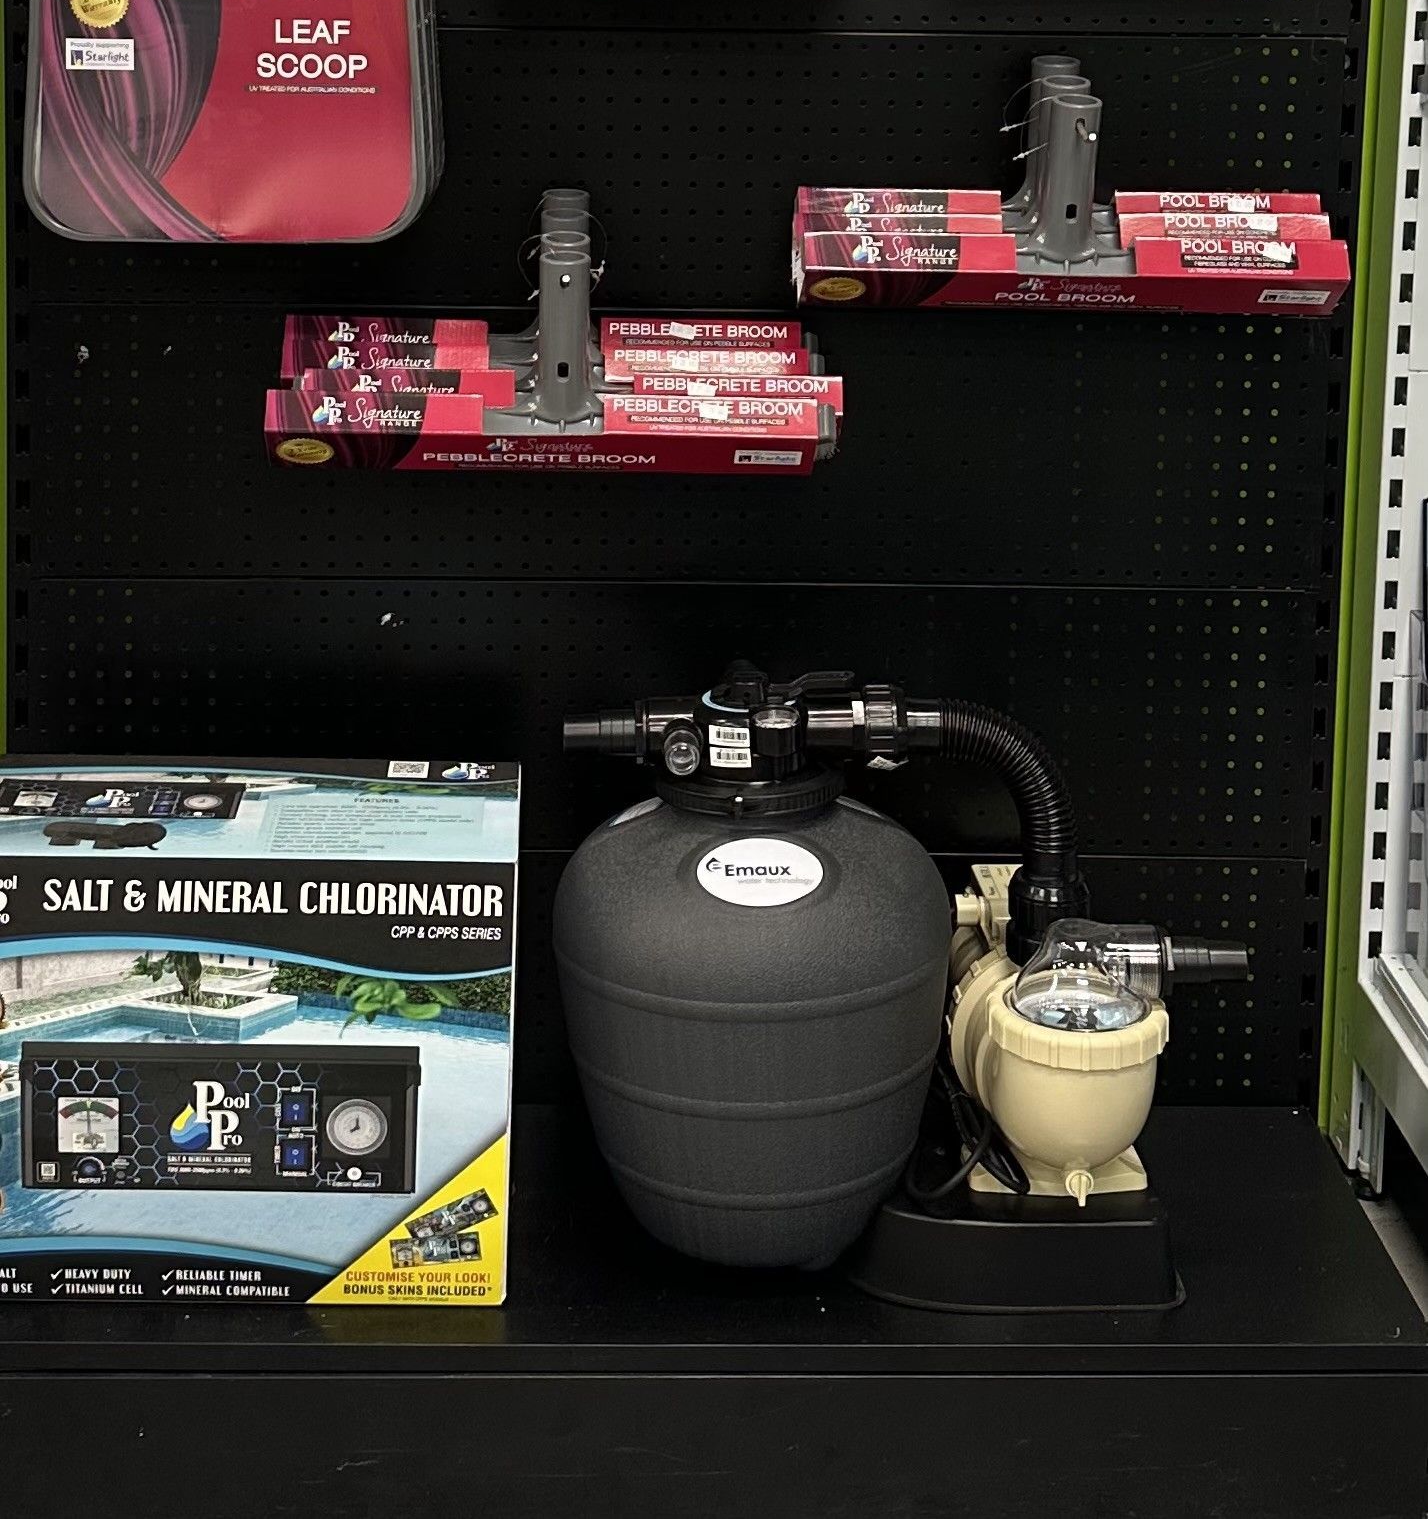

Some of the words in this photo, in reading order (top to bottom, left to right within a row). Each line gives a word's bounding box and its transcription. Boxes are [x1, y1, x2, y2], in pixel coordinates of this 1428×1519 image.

[275, 19, 350, 44] LEAF
[85, 50, 129, 62] Starlight
[257, 53, 367, 79] SCOOP
[1160, 195, 1205, 208] POOL
[1164, 215, 1211, 228] POOL
[886, 236, 958, 266] Signature
[1181, 240, 1228, 254] POOL
[995, 293, 1050, 301] POOL
[1057, 294, 1136, 303] BROOM
[727, 325, 787, 339] BROOM
[734, 351, 796, 364] BROOM
[765, 379, 828, 393] BROOM
[348, 397, 422, 428] Signature
[738, 401, 803, 415] BROOM
[423, 453, 572, 463] PEBBLECRETE
[578, 454, 656, 464] BROOM
[725, 864, 791, 877] Emaux
[43, 878, 113, 912] SALT
[123, 880, 146, 912] &
[158, 880, 288, 913] MINERAL
[300, 882, 503, 916] CHLORINATOR
[391, 925, 415, 939] CPP
[417, 926, 425, 938] &
[427, 926, 458, 939] CPPS
[461, 927, 501, 940] SERIES
[193, 1081, 250, 1123] Pool
[207, 1110, 242, 1151] Pro
[65, 1269, 98, 1280] HEAVY
[103, 1269, 131, 1280] DUTY
[176, 1270, 225, 1280] RELIABLE
[229, 1271, 261, 1281] TIMER
[346, 1271, 413, 1282] CUSTOMISE
[418, 1272, 449, 1282] YOUR
[455, 1272, 490, 1282] LOOK!
[13, 1283, 33, 1293] USE
[65, 1285, 114, 1295] TITANIUM
[119, 1285, 143, 1295] CELL
[176, 1285, 222, 1296] MINERAL
[226, 1286, 290, 1296] COMPATIBLE
[343, 1284, 384, 1294] BONUS
[388, 1285, 423, 1295] SKINS
